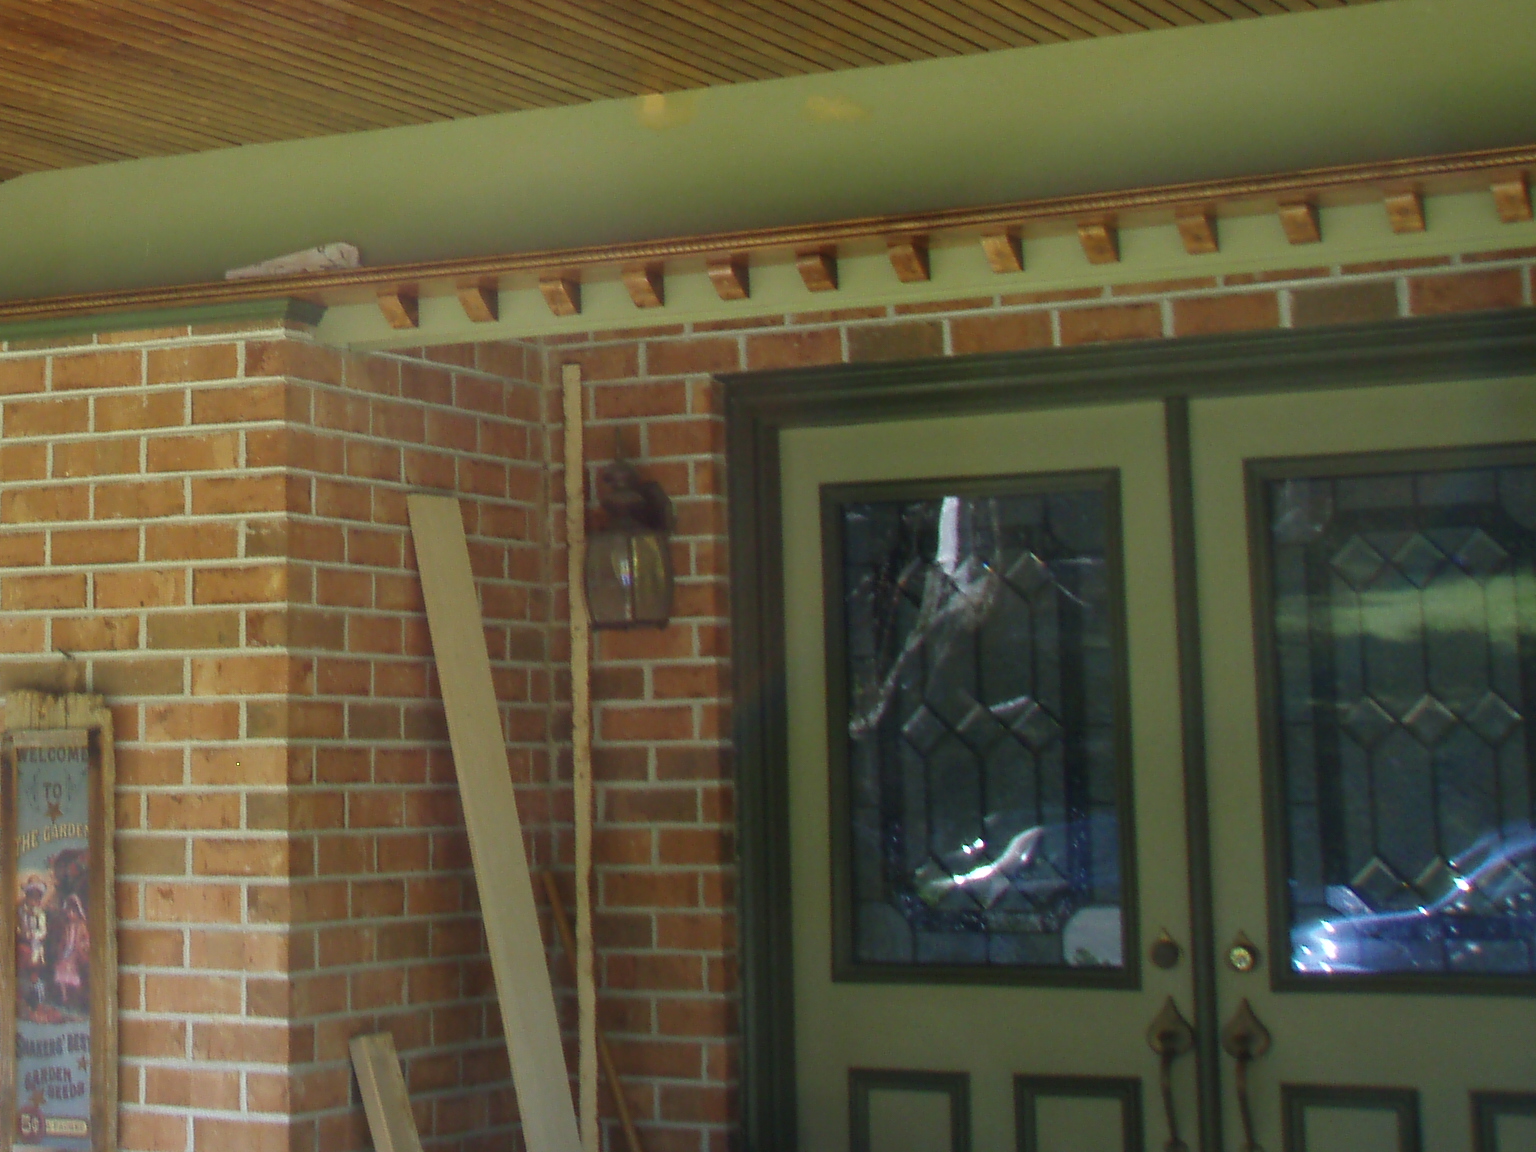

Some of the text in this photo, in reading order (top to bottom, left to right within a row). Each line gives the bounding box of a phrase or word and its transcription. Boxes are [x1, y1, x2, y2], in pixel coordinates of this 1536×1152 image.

[16, 747, 88, 762] WELCOME
[43, 782, 62, 799] TO
[15, 830, 39, 856] THE
